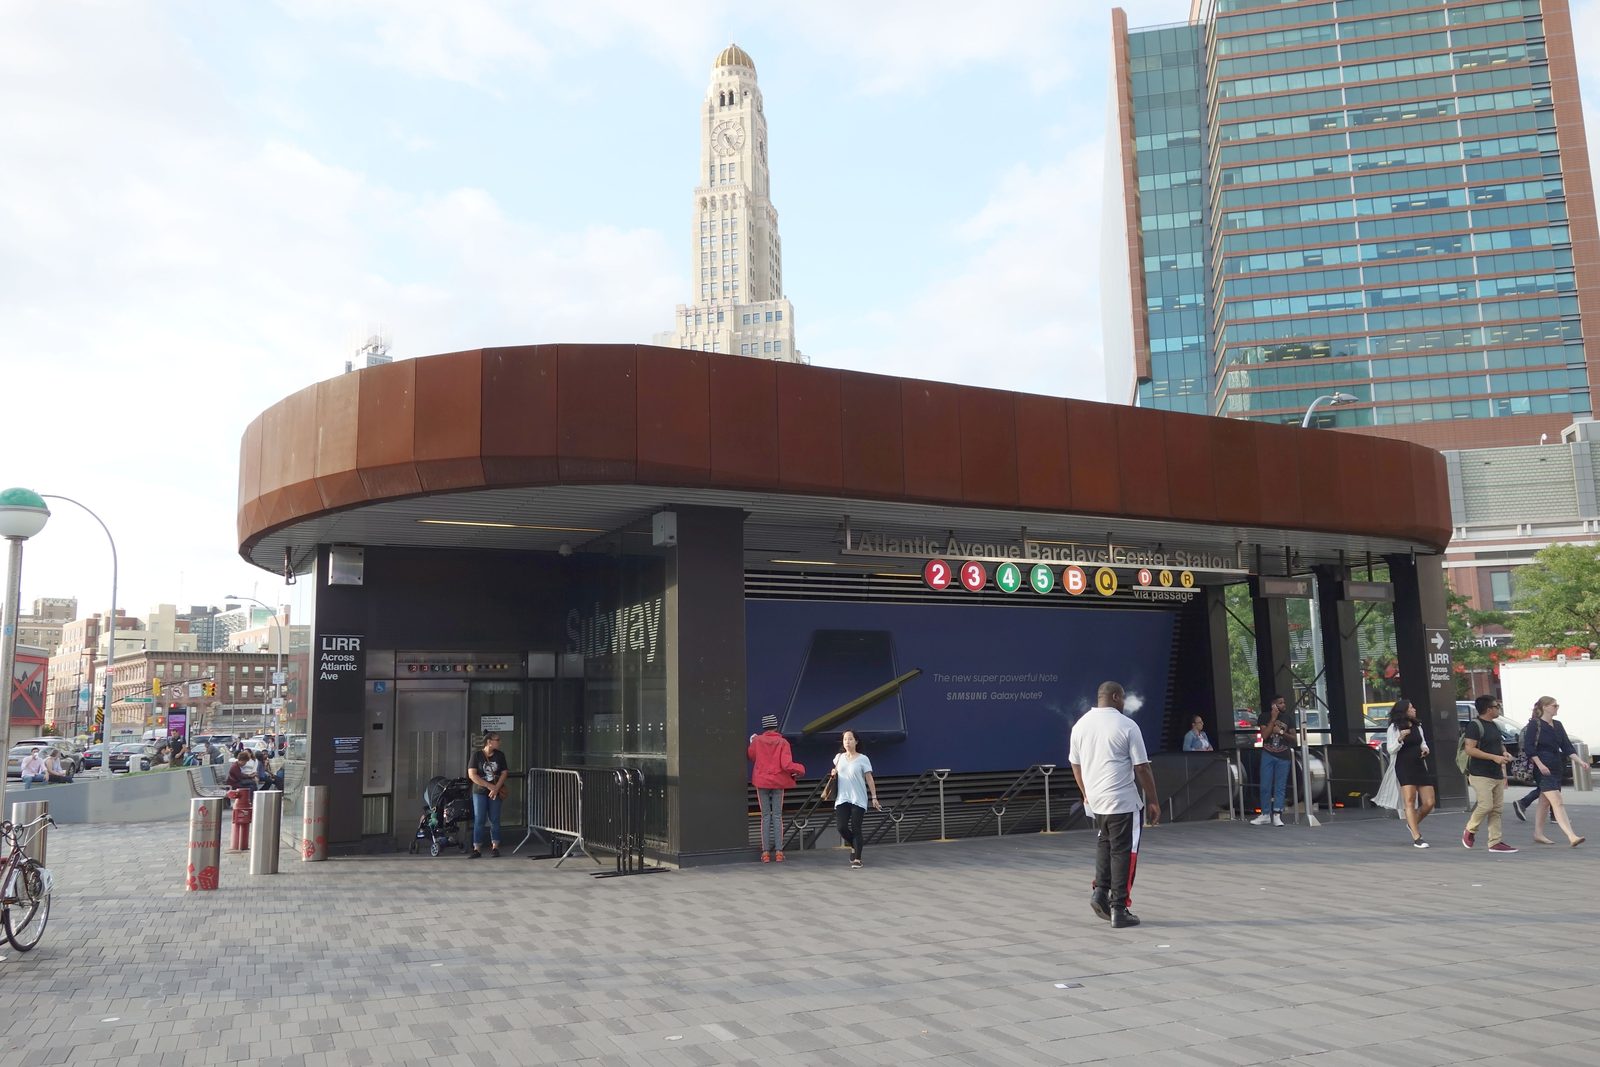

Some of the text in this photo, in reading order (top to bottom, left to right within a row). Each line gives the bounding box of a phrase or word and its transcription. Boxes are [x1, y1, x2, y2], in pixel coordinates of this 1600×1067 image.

[858, 532, 1231, 569] Atlantic Avenue Barclays Center Station
[932, 563, 1192, 591] 2 3 4 5 B Q D N R
[1134, 590, 1193, 603] via passage
[322, 637, 360, 651] LIRR
[321, 653, 355, 661] Across
[1429, 653, 1450, 664] LIRR
[320, 662, 358, 671] Atlantic
[1430, 665, 1448, 673] Across
[320, 671, 338, 680] Ave
[933, 673, 1058, 685] The new super powerful Note
[1431, 673, 1450, 681] Atlantic
[946, 691, 1043, 701] SAMSUNG Galaxy Note9
